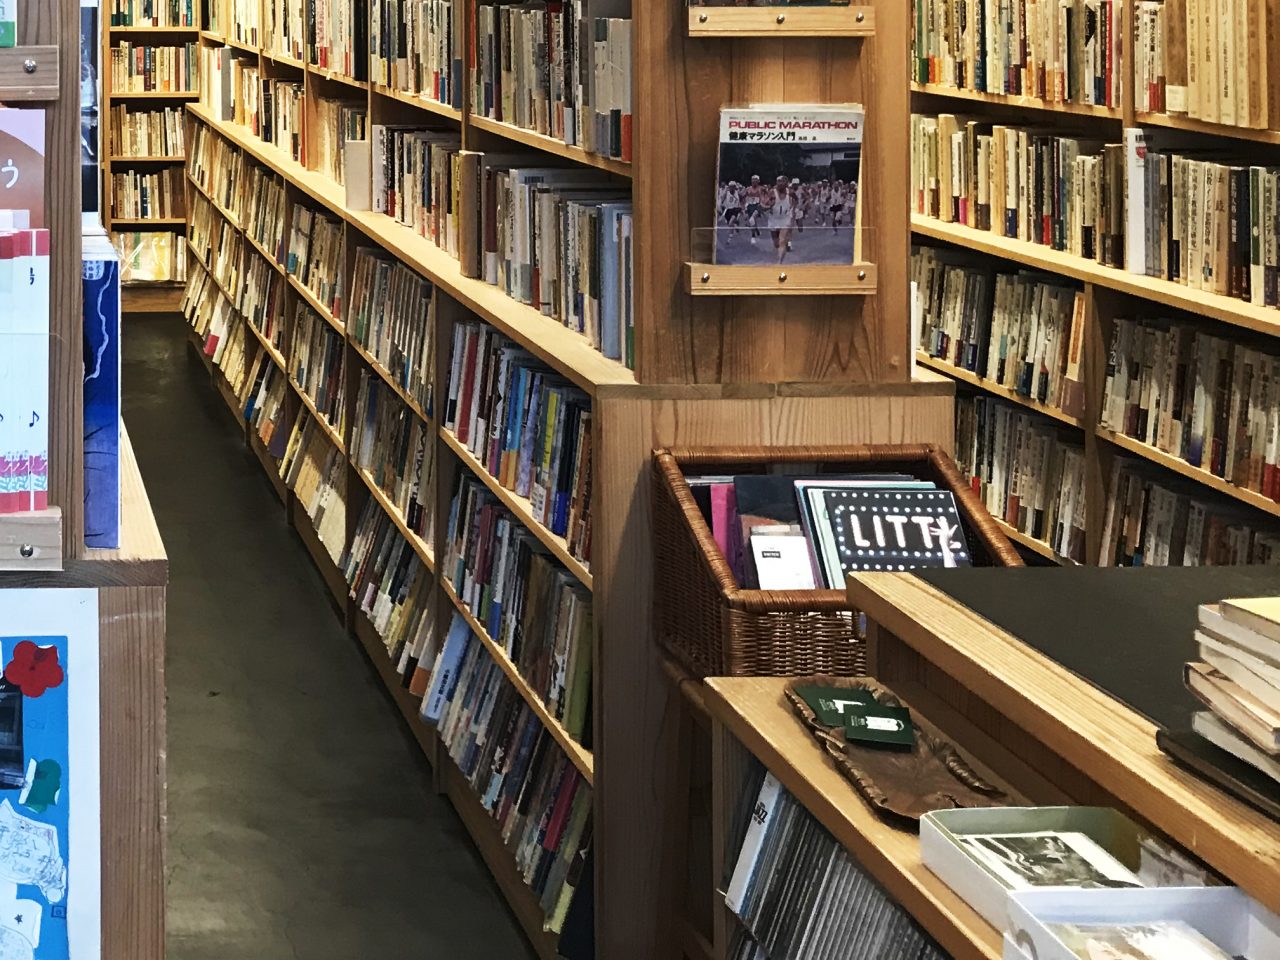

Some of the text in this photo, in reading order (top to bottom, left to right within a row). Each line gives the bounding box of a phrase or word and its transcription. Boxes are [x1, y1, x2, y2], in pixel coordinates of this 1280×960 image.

[728, 121, 858, 129] PUBLIC MARATHON
[728, 131, 796, 142] 健康マラソン入門
